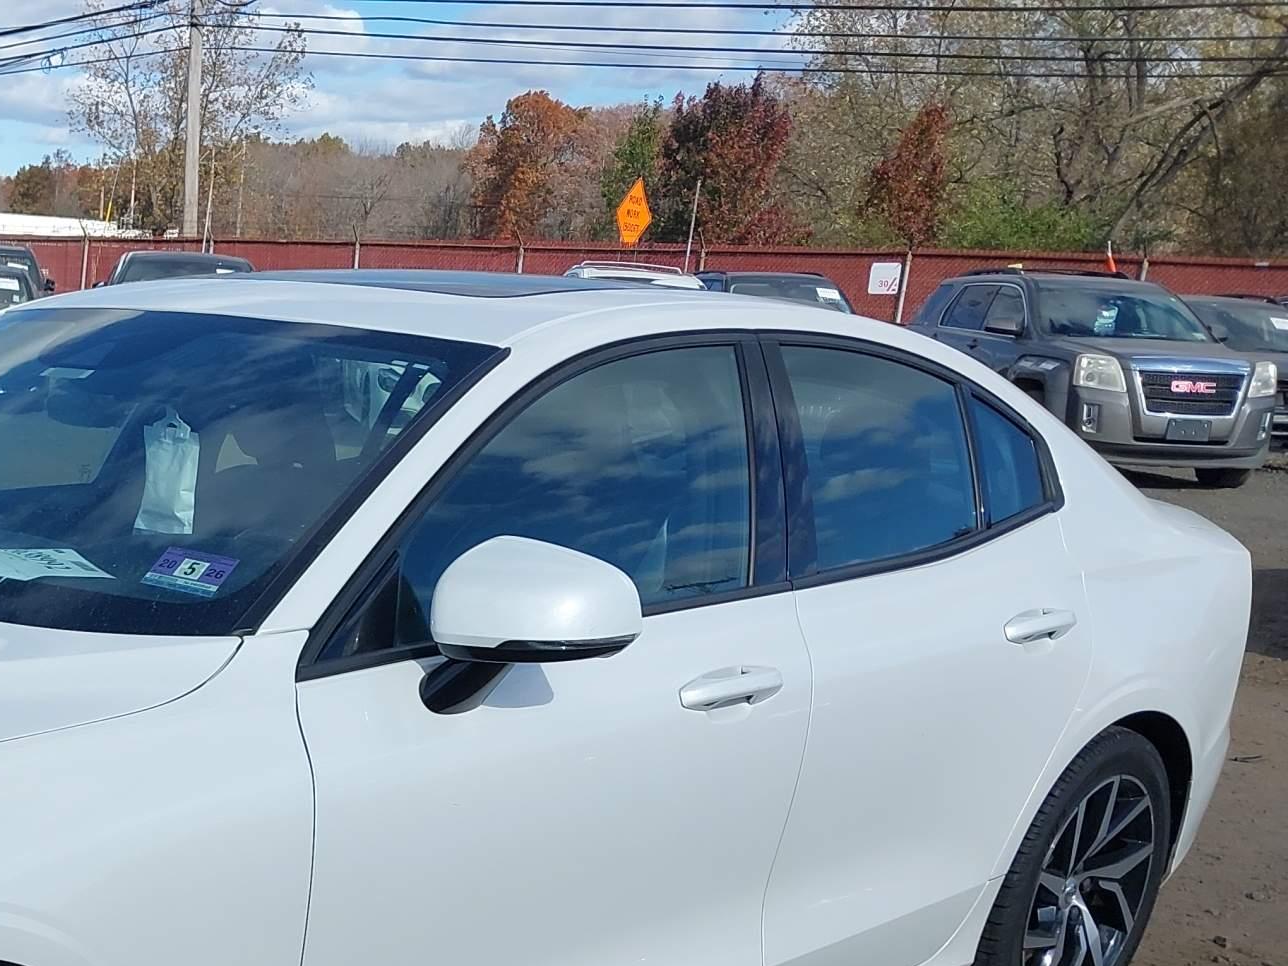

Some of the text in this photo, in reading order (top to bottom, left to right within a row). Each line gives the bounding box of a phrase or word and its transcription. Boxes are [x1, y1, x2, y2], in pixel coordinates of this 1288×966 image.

[629, 194, 643, 206] ROAD
[626, 208, 641, 219] WORK
[1171, 381, 1216, 393] GMC
[158, 558, 226, 580] 20 5 26
